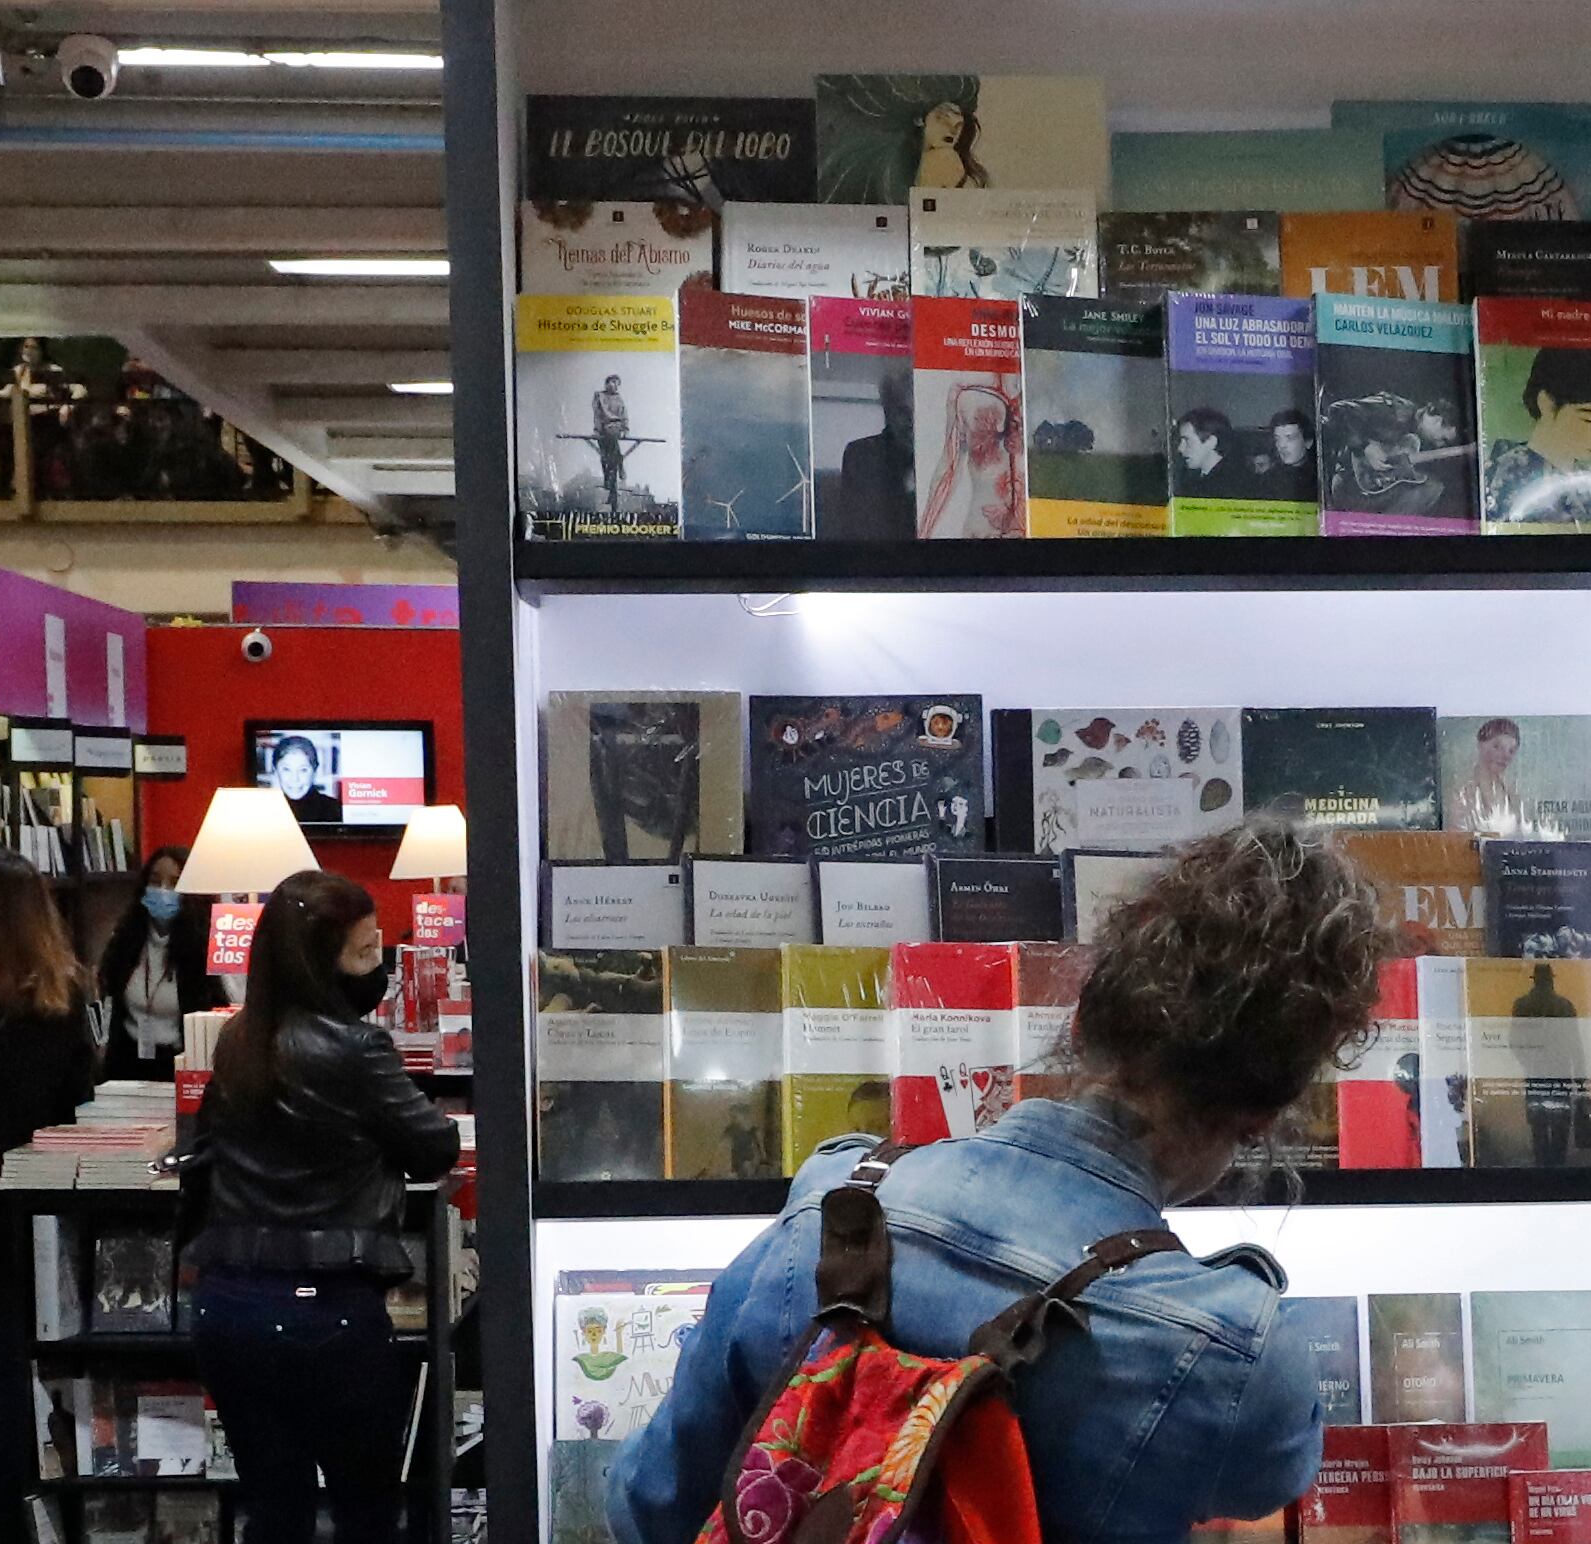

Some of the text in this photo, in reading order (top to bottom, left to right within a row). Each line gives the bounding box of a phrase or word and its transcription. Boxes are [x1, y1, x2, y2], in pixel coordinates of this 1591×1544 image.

[545, 236, 690, 276] Reinas del Abismo
[789, 259, 806, 271] del
[809, 262, 830, 274] agua
[1309, 265, 1443, 301] LEM
[731, 306, 791, 318] Huesos de
[859, 308, 895, 318] VIVIAN
[1194, 302, 1254, 316] JON SAVAGE
[1542, 309, 1590, 322] Mi madre
[1083, 310, 1143, 323] JANE SMILEY
[538, 319, 654, 335] Historia de Shuggie
[728, 321, 753, 333] MIKE
[1195, 318, 1243, 333] UNA LUZ
[1335, 320, 1433, 339] CARLOS VELÁZQUEZ
[1195, 333, 1287, 348] EL SOL Y TODO LO
[575, 524, 669, 535] PREMIO BOOKER
[804, 760, 930, 800] MUJERES DE
[348, 788, 388, 798] Gornick
[1305, 797, 1379, 813] MEDICINA
[808, 793, 932, 840] CIENCIA
[1089, 806, 1181, 819] NATURALISTA
[1307, 812, 1378, 825] SAGRADA
[831, 830, 930, 856] INTRÉPIDAS PIONERAS
[416, 902, 446, 915] des-
[416, 916, 463, 927] taca-
[416, 928, 439, 938] dos
[213, 950, 244, 963] dos
[1403, 1375, 1436, 1389] OTOÑO
[1506, 1374, 1564, 1385] PRIMAVERA
[1317, 1472, 1360, 1484] TERCERA
[1413, 1467, 1508, 1480] BAJO LA SUPERFICIE
